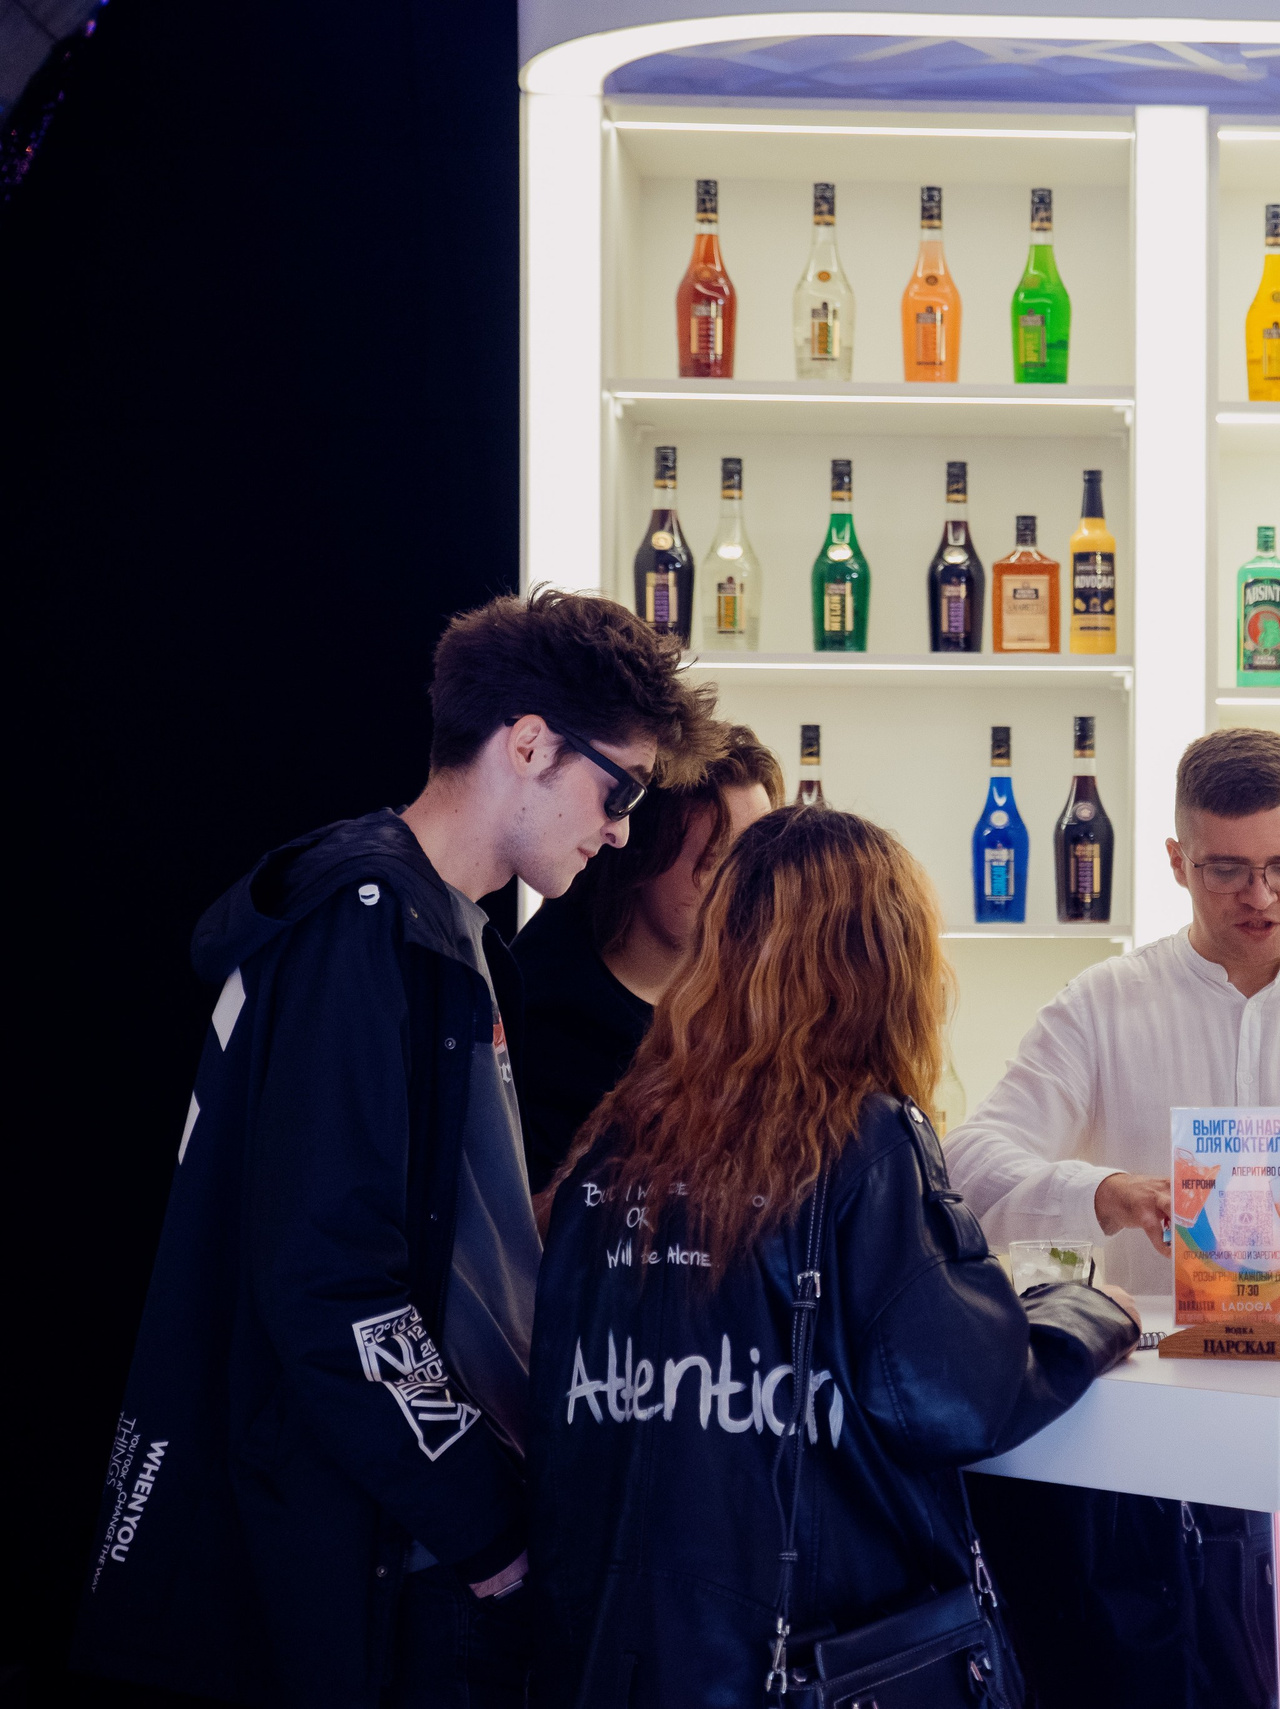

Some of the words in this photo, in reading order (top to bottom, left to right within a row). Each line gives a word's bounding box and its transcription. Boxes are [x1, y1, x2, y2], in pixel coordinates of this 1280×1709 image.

[1193, 1117, 1255, 1136] ВЫИГРАЙ
[1195, 1137, 1221, 1154] ДЛЯ
[1232, 1167, 1276, 1177] АПЕРИТИВО
[1181, 1179, 1216, 1189] НЕГРОНИ
[606, 1238, 632, 1269] Will
[1237, 1284, 1259, 1296] 17:30
[1221, 1302, 1273, 1312] LADOGA
[1225, 1327, 1254, 1335] ВОДКА
[1203, 1339, 1276, 1356] ЦАРСКАЯ
[566, 1328, 844, 1449] Attention
[106, 1418, 137, 1487] THINGS
[128, 1434, 141, 1453] YOU
[127, 1440, 170, 1513] WHEN
[105, 1491, 127, 1542] CHANGE
[110, 1514, 142, 1563] YOU
[98, 1543, 111, 1567] THE
